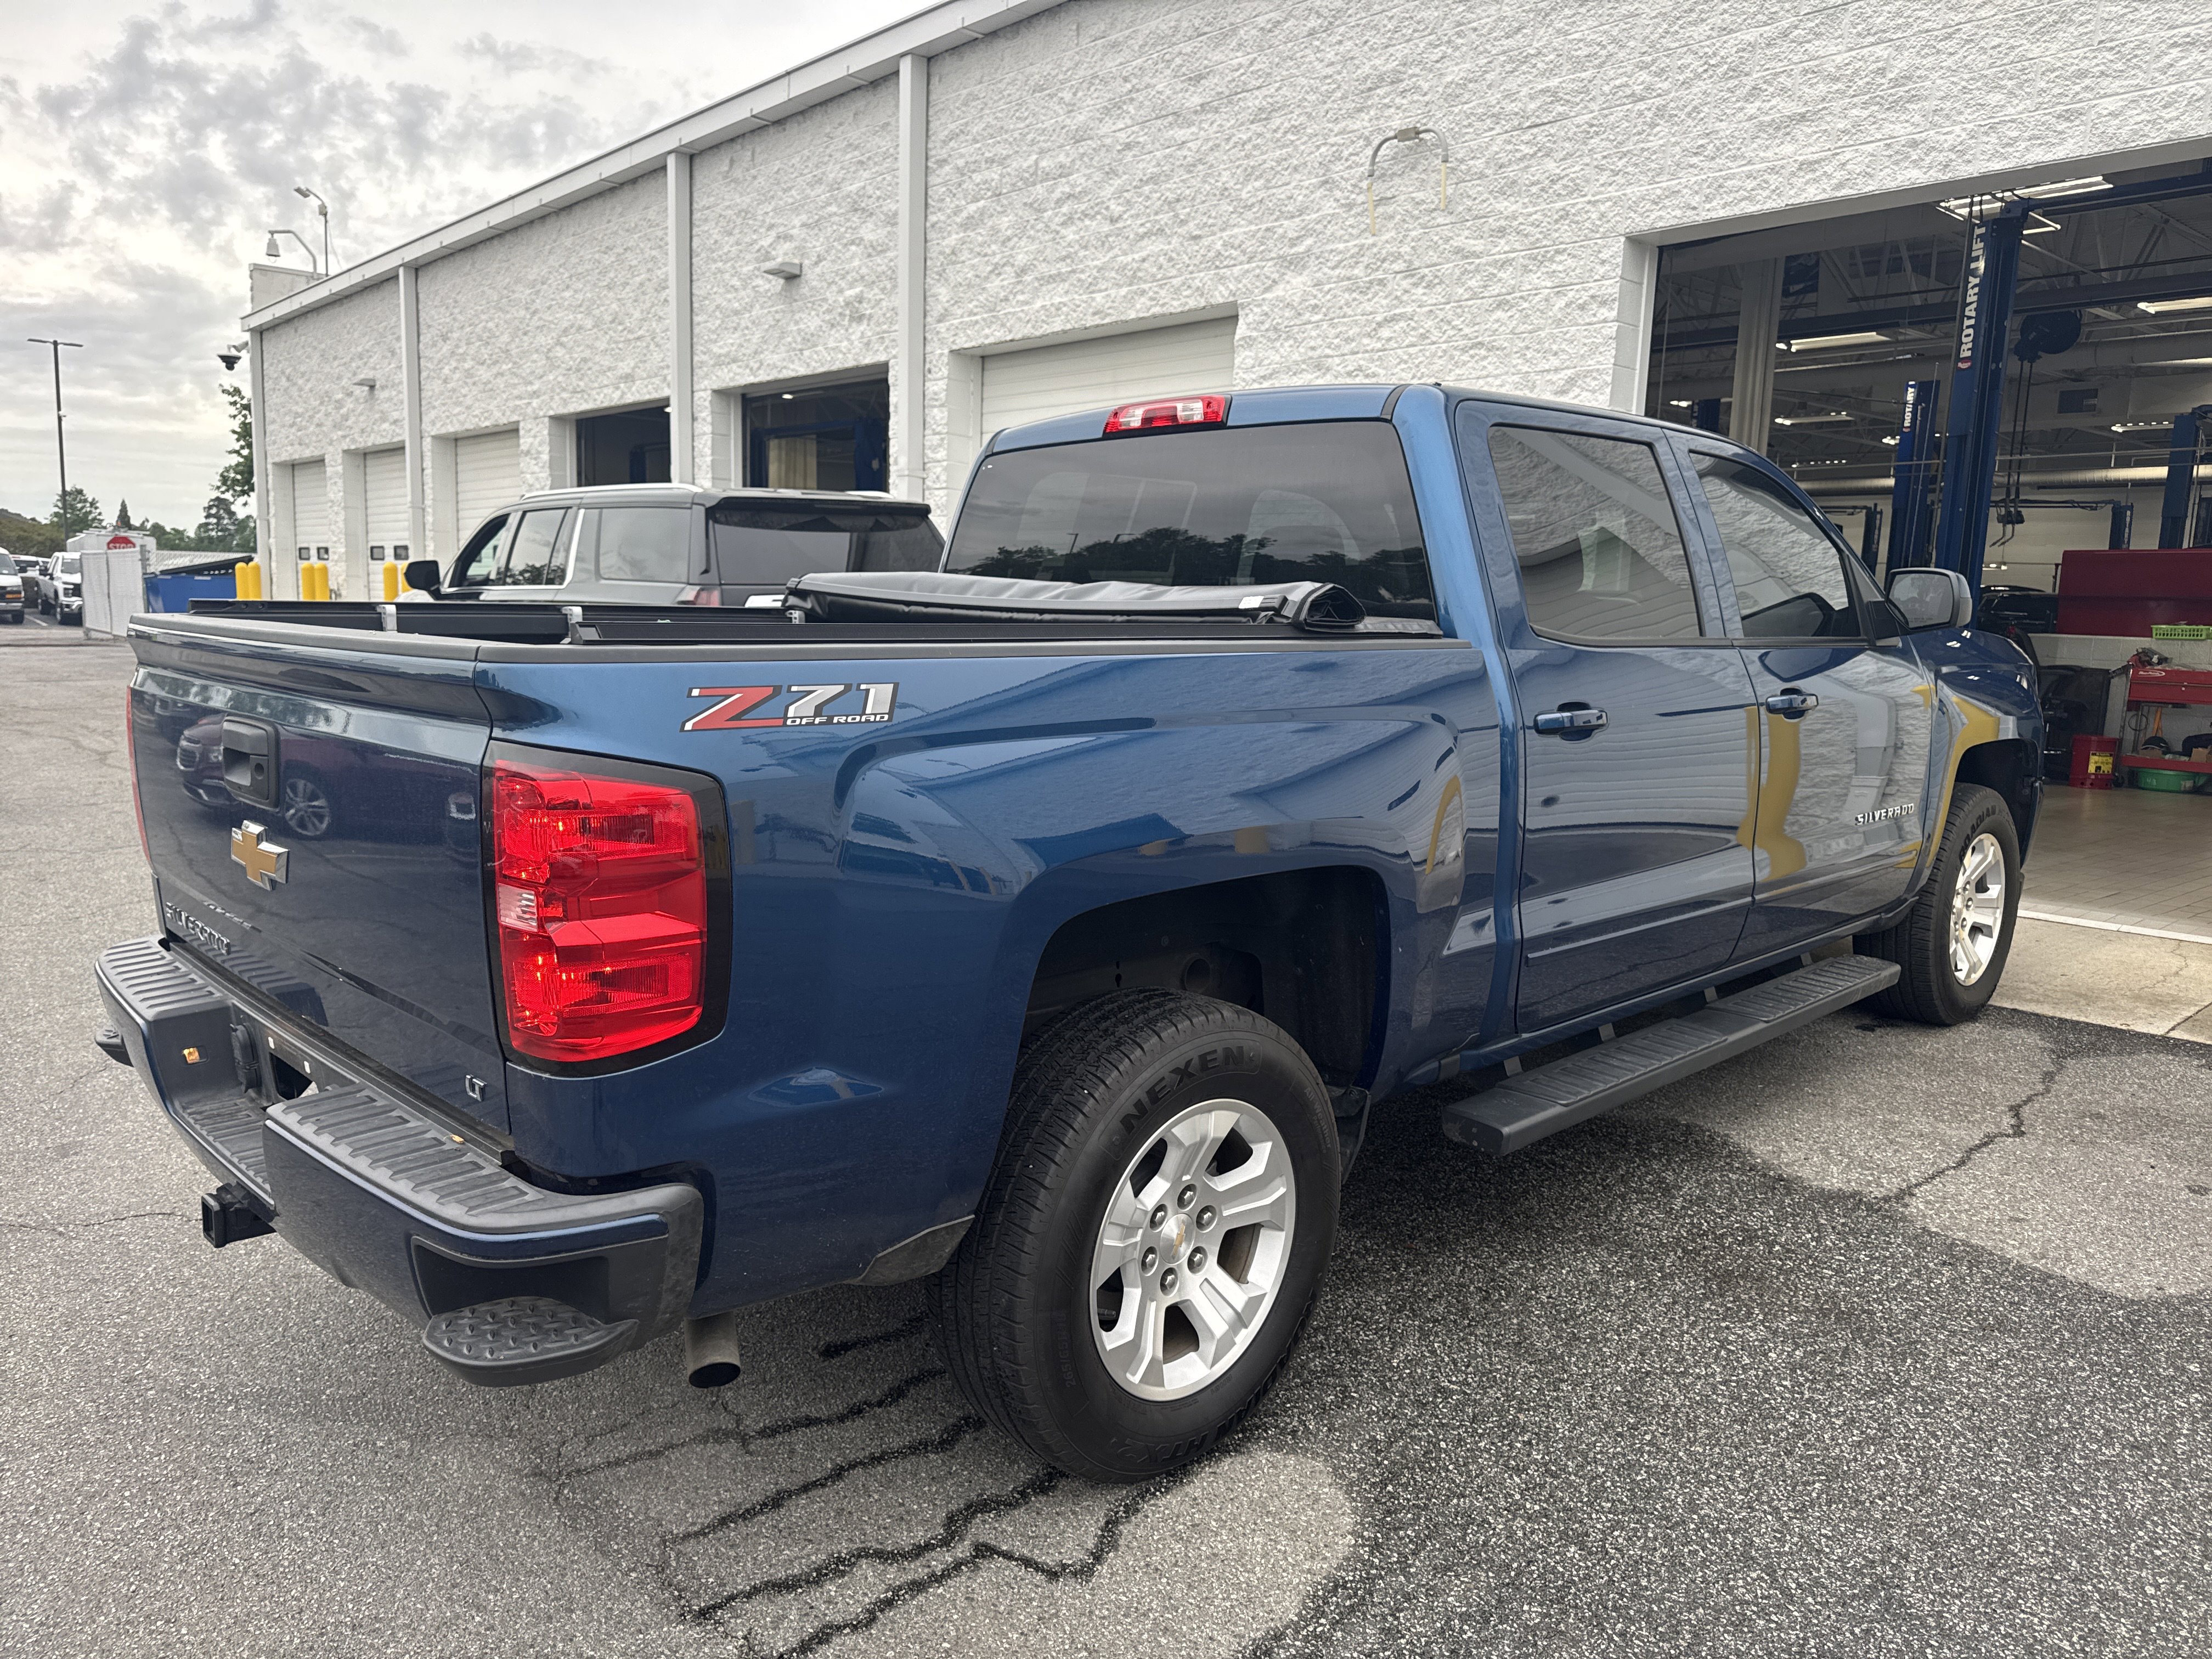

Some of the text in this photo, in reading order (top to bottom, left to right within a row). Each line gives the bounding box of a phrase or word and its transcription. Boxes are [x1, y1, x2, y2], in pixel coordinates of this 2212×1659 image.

[1959, 275, 1980, 358] ROTARY
[1970, 225, 1986, 274] LIFT
[1903, 386, 1915, 427] ROTARY
[679, 682, 900, 733] Z71
[786, 714, 889, 726] OFF ROAD
[1855, 803, 1915, 826] SILVERADO
[465, 1074, 488, 1102] LT
[1119, 1045, 1244, 1135] NEXEN
